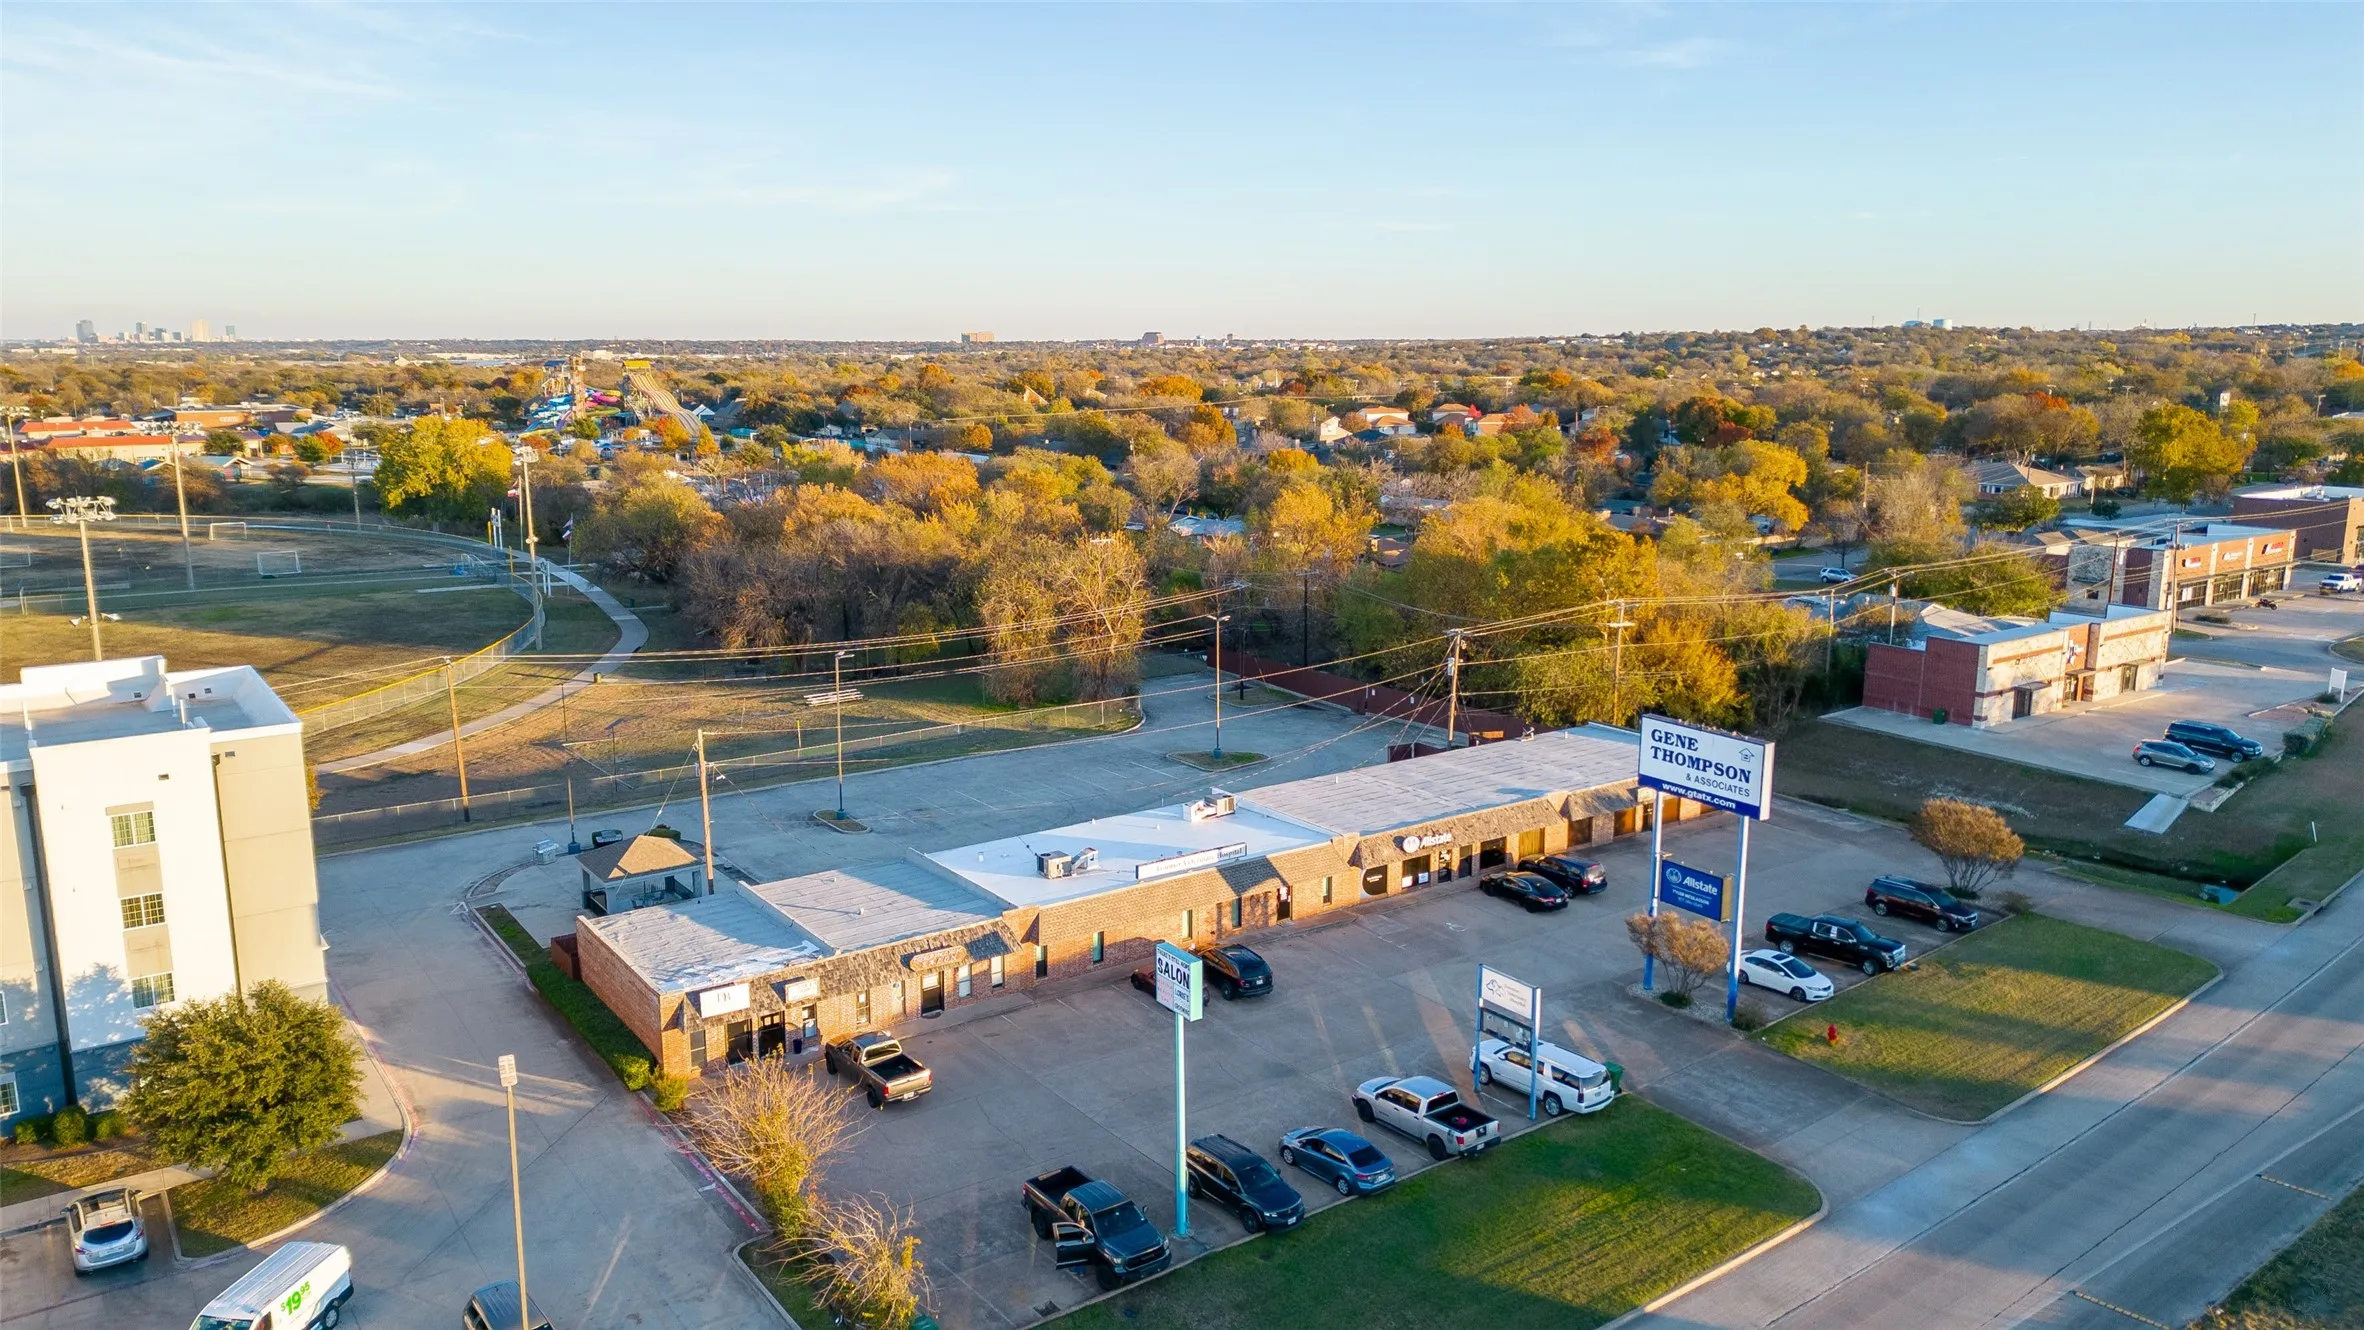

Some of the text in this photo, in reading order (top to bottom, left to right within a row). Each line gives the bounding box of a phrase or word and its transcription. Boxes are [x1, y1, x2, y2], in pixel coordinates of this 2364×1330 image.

[1651, 729, 1699, 752] GENE
[1650, 745, 1751, 784] THOMPSON
[1662, 782, 1736, 810] www.gtatx.com
[1685, 773, 1750, 798] & ASSOCIATES
[1420, 832, 1454, 849] Allstate
[1217, 847, 1243, 860] Hospital
[1682, 876, 1718, 896] Allstate
[1157, 957, 1190, 990] SALON
